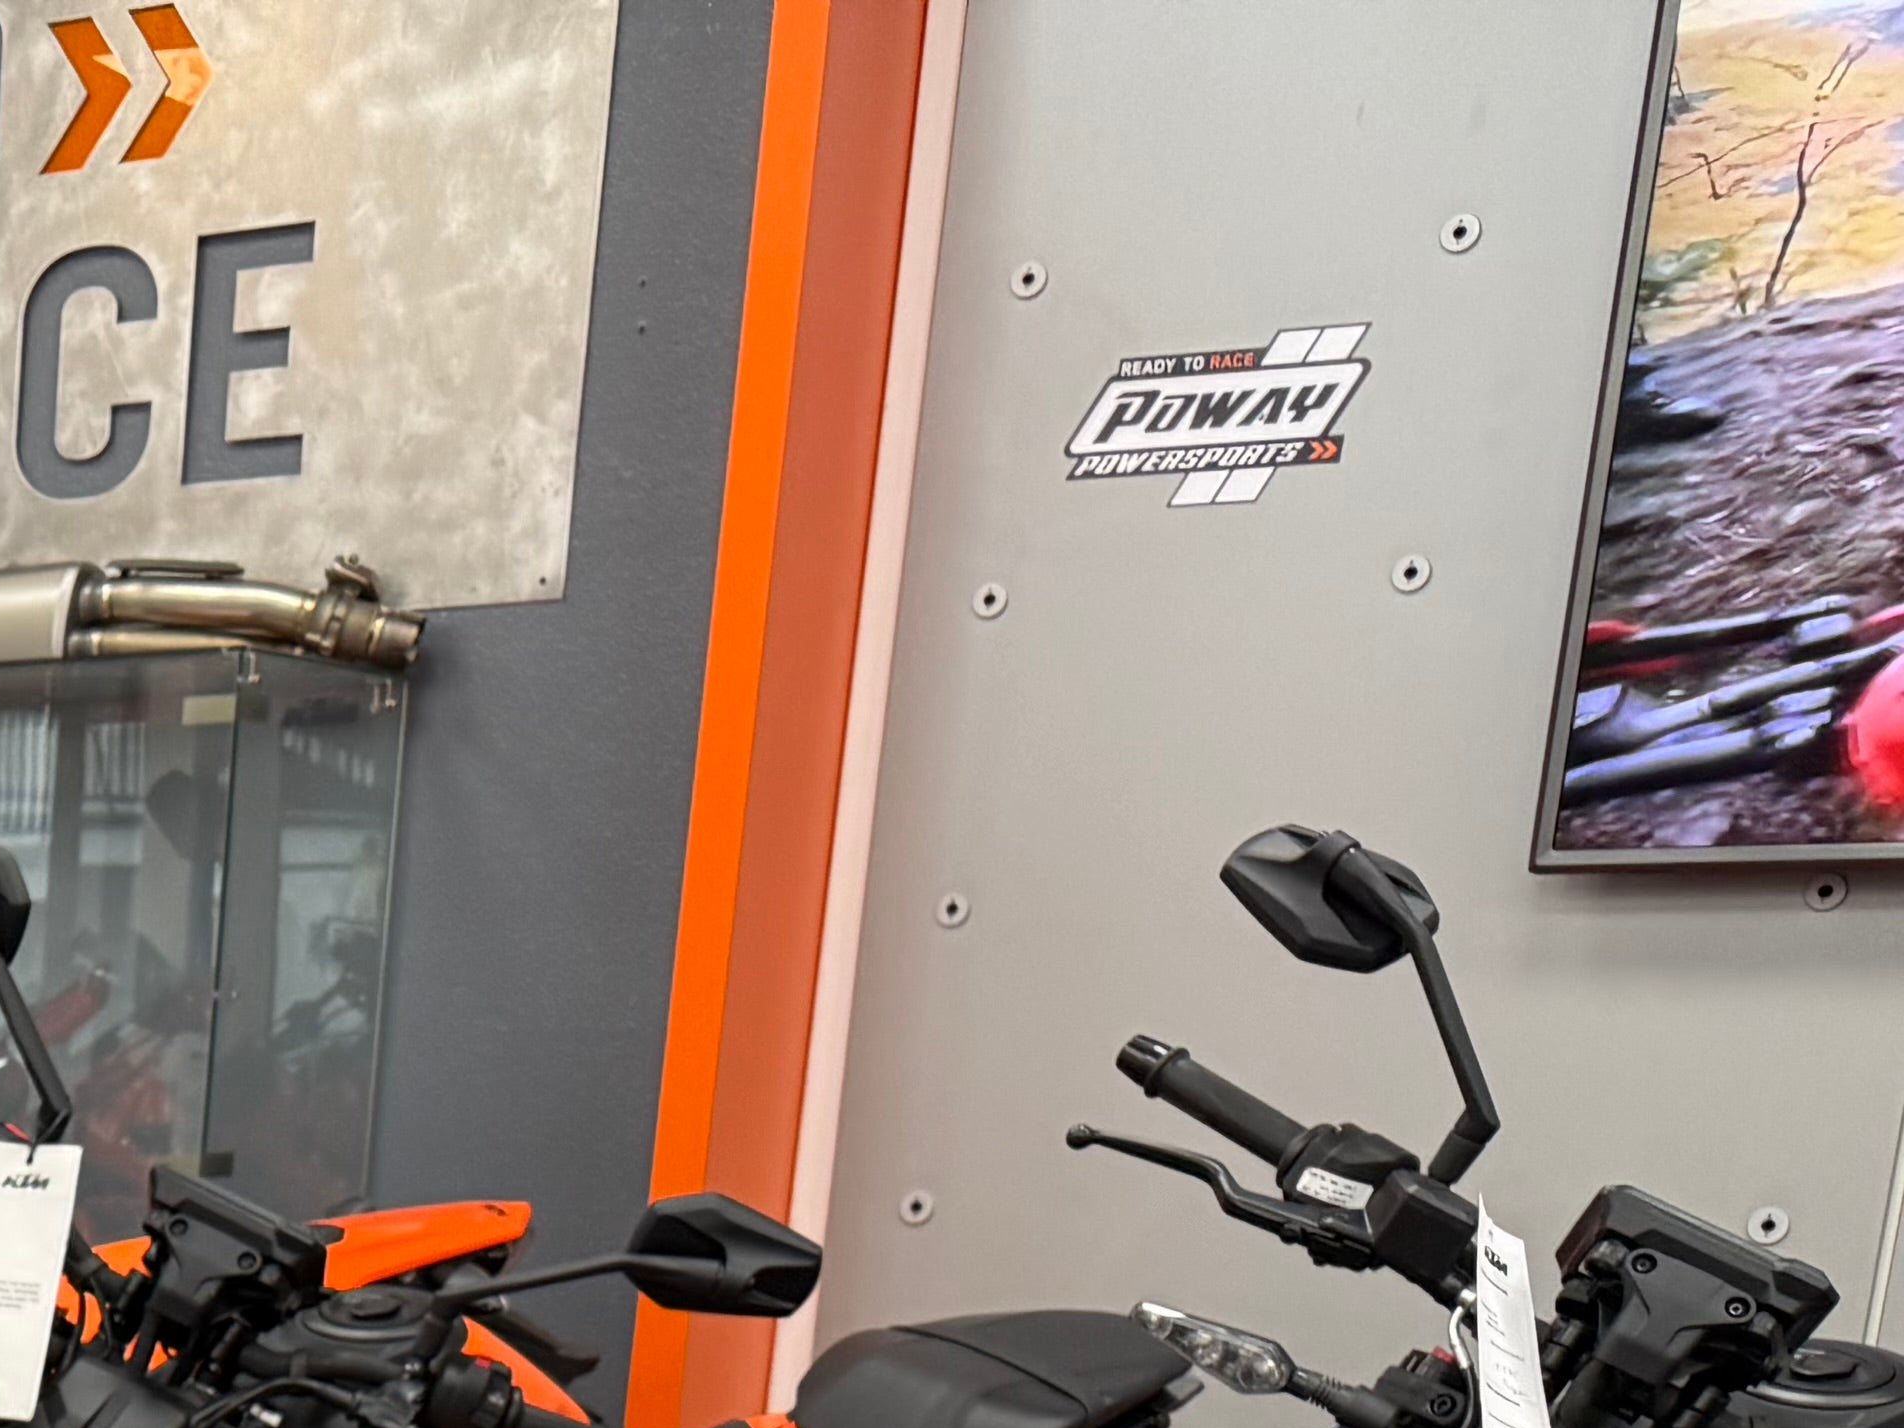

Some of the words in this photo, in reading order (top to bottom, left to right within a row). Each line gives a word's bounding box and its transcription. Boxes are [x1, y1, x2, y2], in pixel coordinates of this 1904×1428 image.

[1120, 357, 1177, 377] READY
[1184, 356, 1205, 372] TO
[1209, 351, 1256, 370] RACE
[1091, 382, 1341, 445] POWAY
[1074, 440, 1305, 477] POWERSPORTS
